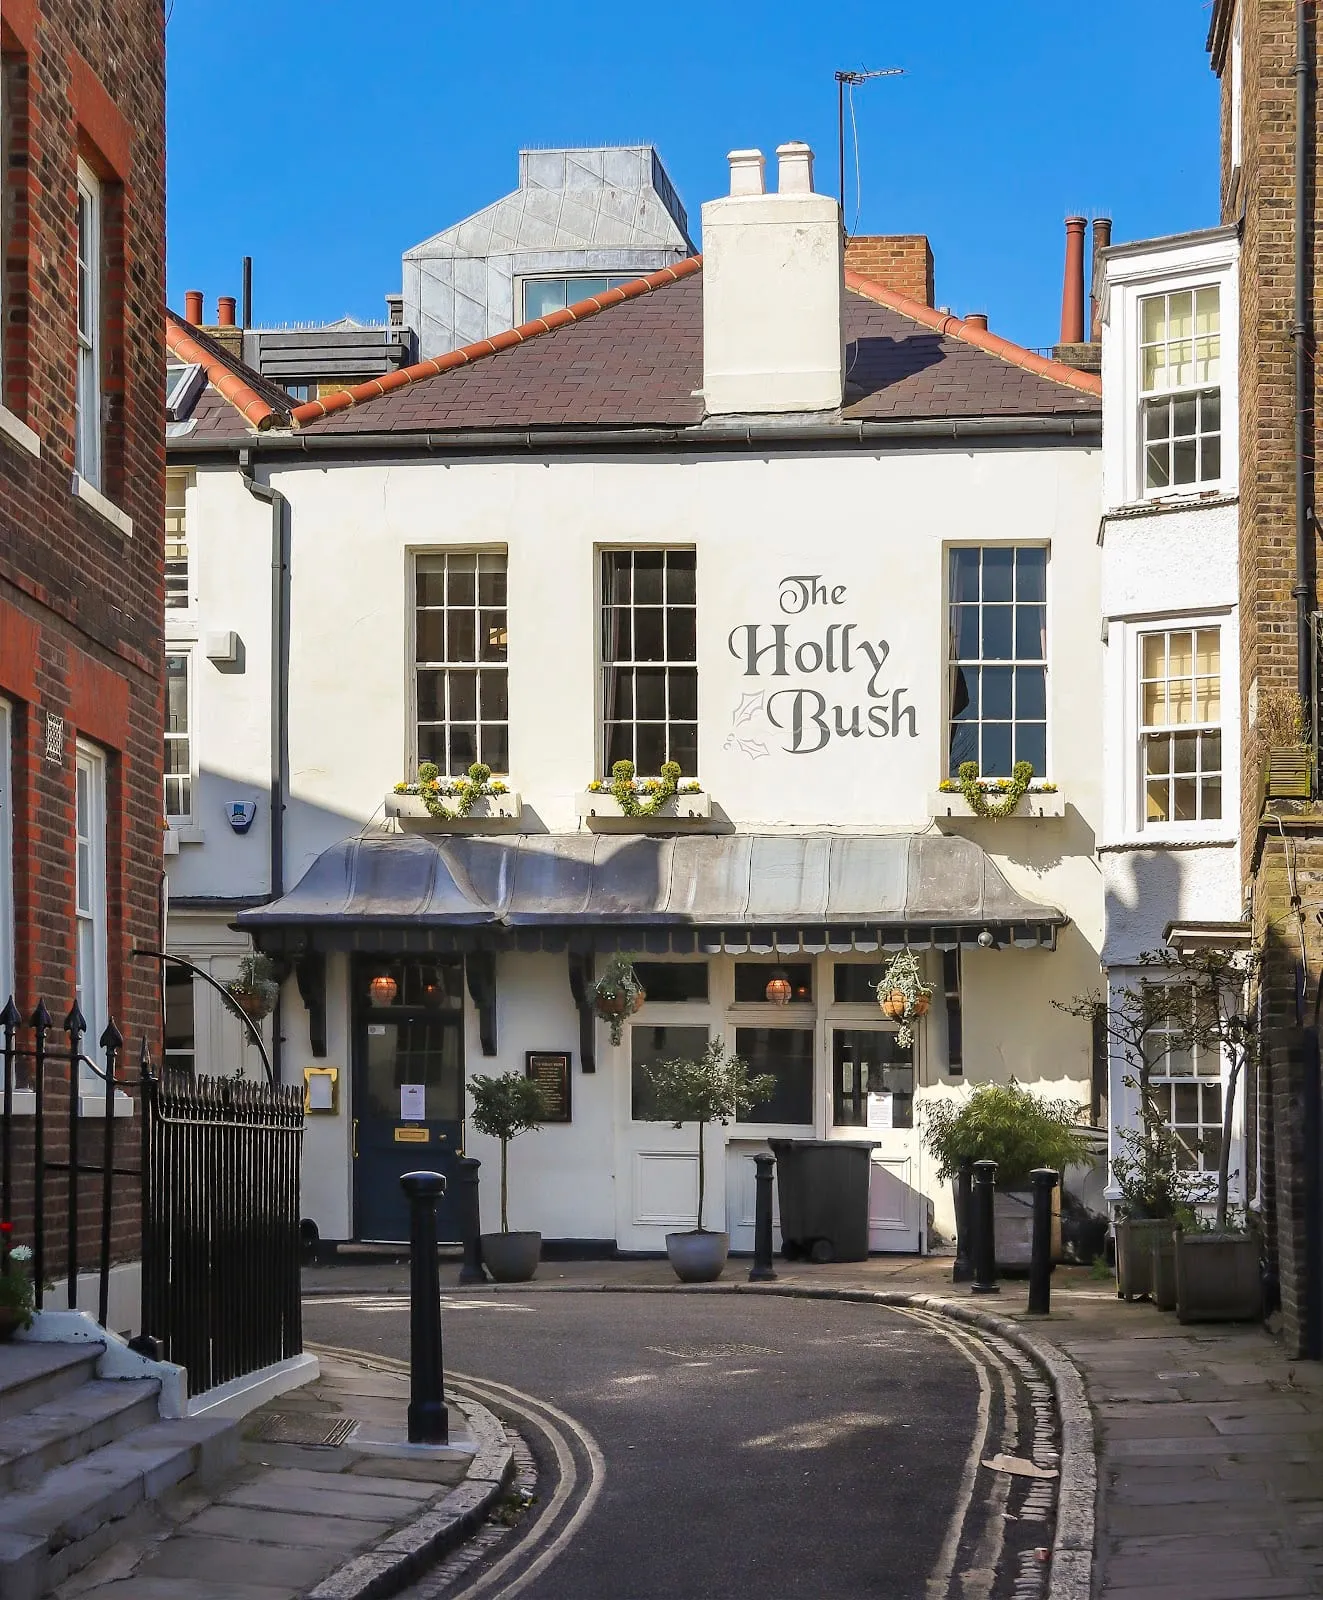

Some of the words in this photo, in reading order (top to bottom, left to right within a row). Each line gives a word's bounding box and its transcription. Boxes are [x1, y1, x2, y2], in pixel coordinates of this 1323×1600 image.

[779, 575, 847, 614] The
[728, 623, 890, 698] Holly
[766, 688, 920, 754] Bush
